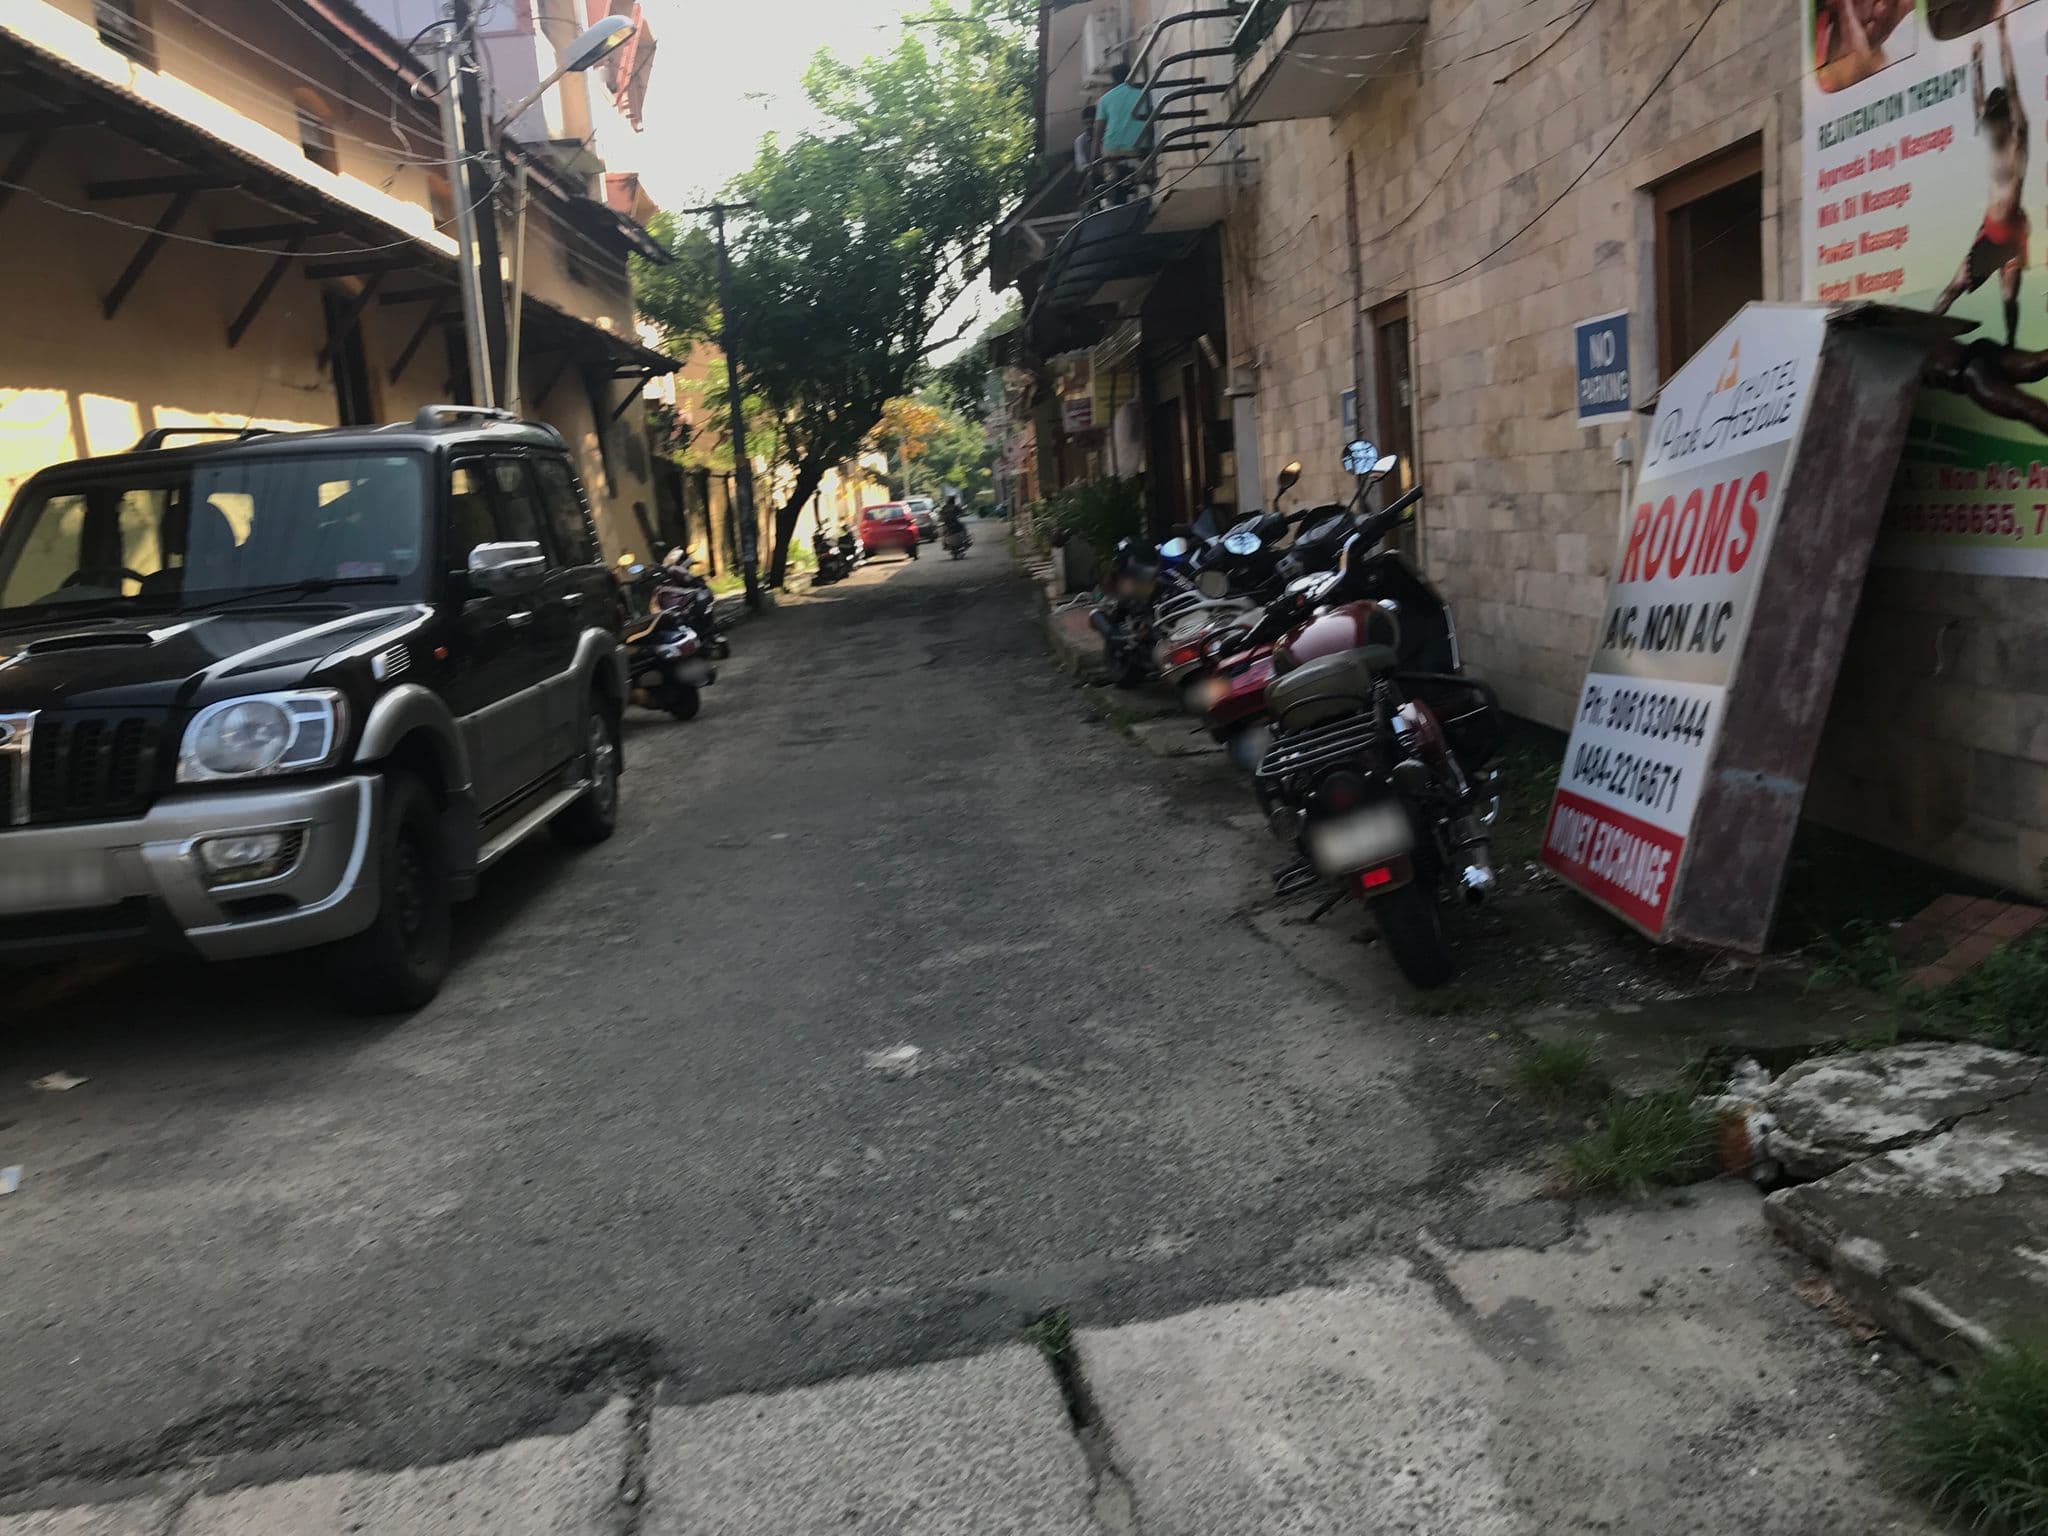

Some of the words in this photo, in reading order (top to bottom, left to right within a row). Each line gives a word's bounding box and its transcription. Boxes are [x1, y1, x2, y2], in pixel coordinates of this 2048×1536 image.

[1589, 329, 1616, 370] NO
[1579, 369, 1630, 404] PARKING
[1617, 469, 1770, 585] ROOMS
[1640, 602, 1693, 652] NON
[1587, 822, 1673, 908] EXCHANGE
